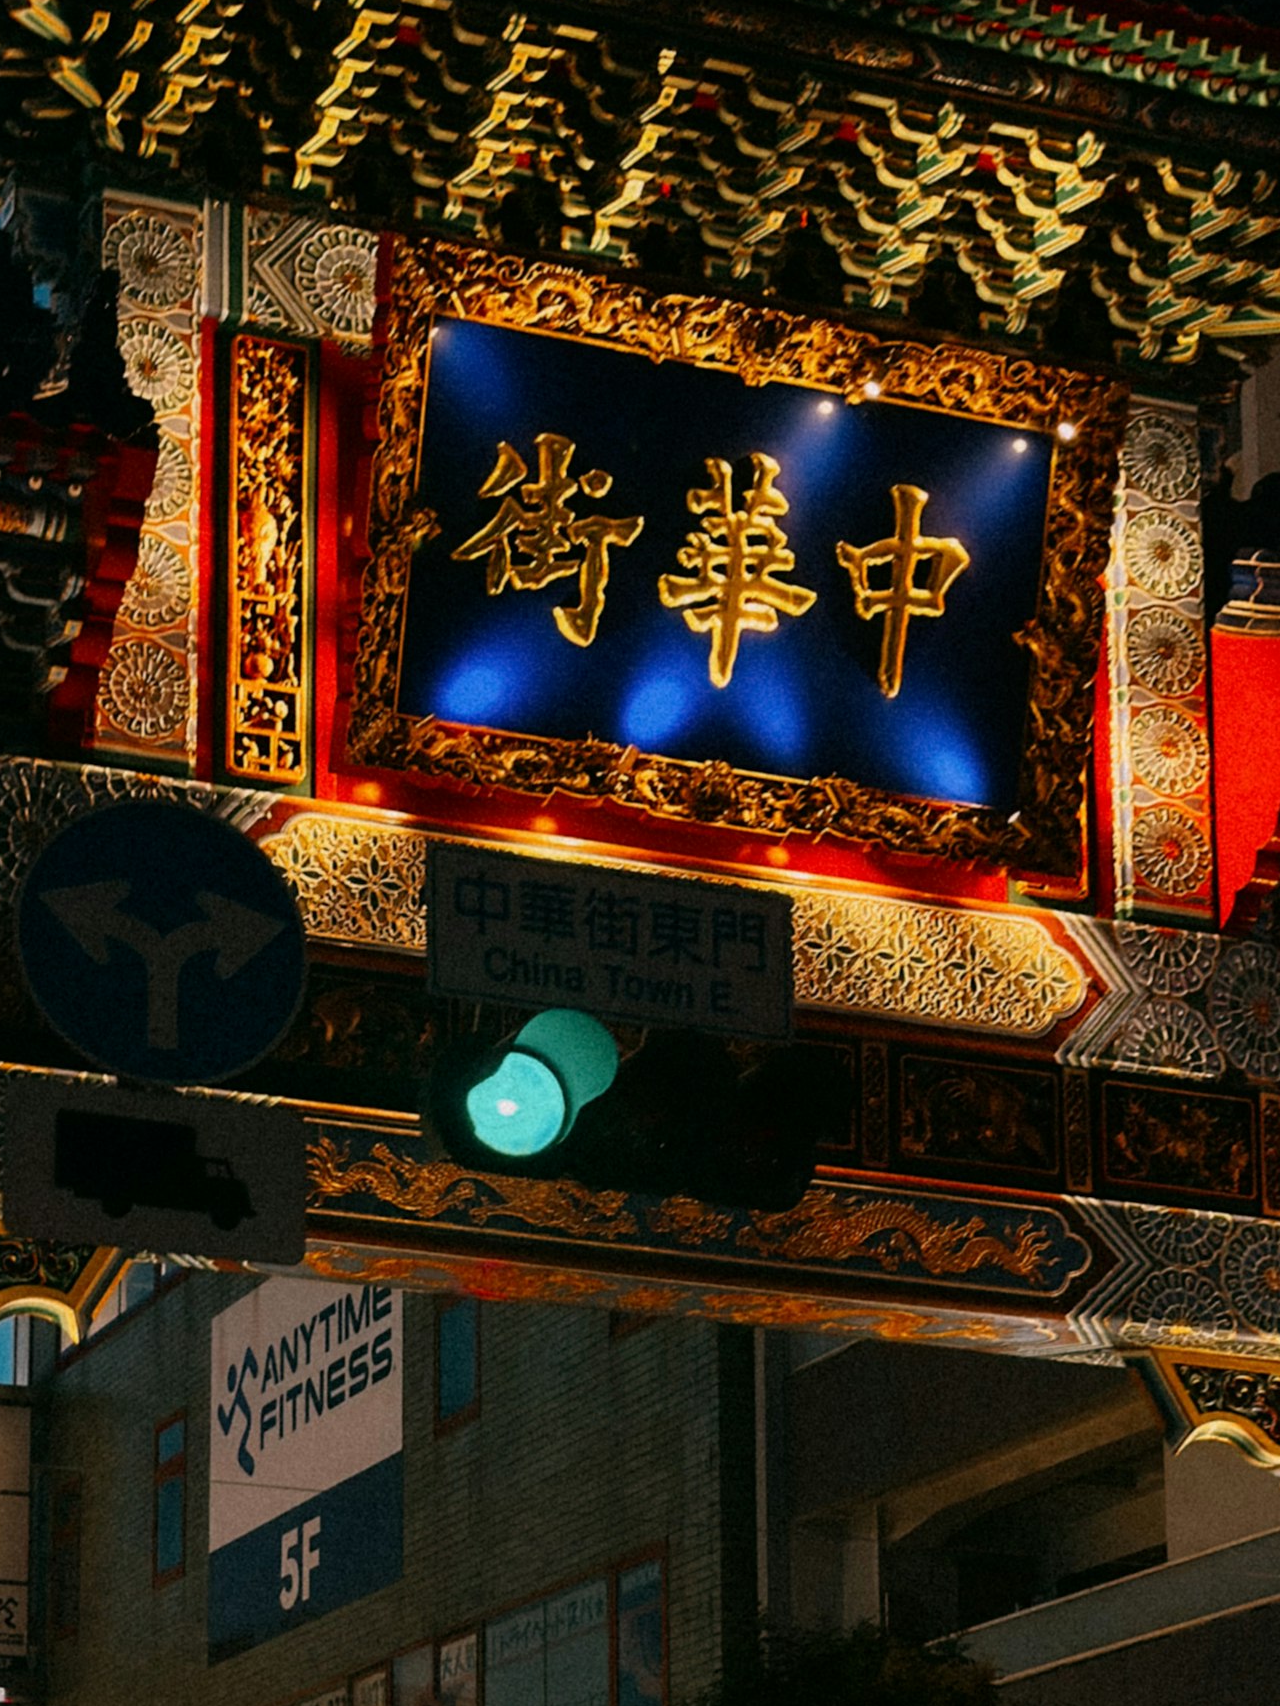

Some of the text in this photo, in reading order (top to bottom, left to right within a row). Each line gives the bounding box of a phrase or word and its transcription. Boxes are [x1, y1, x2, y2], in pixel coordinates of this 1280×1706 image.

[450, 431, 971, 700] 中華街
[454, 873, 767, 973] 中華街東門
[484, 946, 733, 1013] China Town E
[261, 1285, 393, 1394] ANYTIME
[261, 1327, 393, 1451] FITNESS
[279, 1514, 321, 1611] 5F
